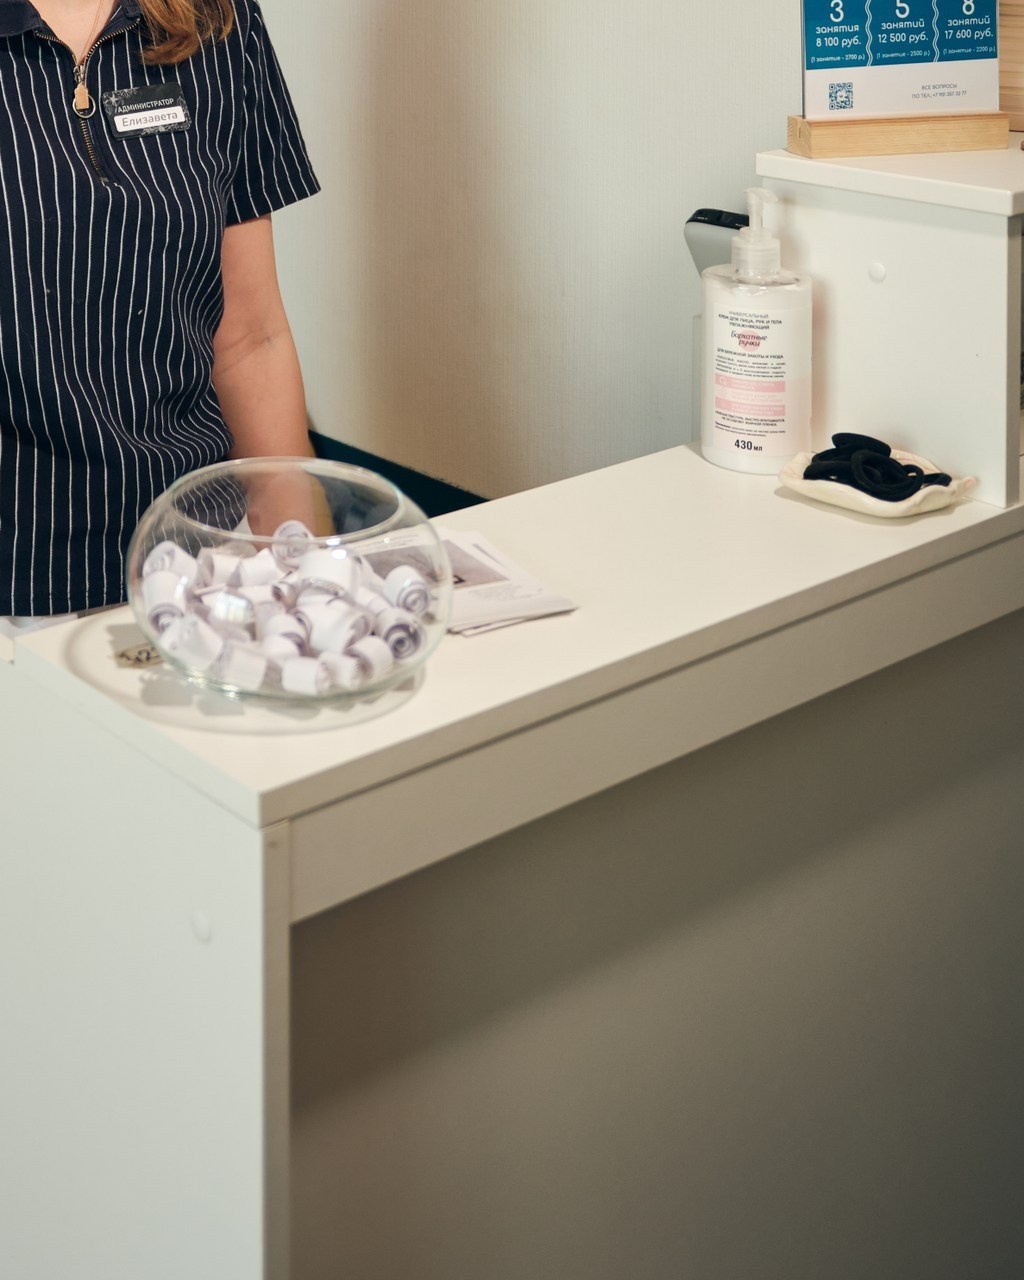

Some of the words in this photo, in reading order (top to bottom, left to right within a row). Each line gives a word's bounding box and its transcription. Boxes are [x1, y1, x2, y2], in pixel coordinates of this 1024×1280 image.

[830, 0, 844, 22] 3
[881, 18, 925, 30] занятий
[948, 15, 990, 27] занятий
[816, 25, 859, 34] занятия
[944, 30, 953, 39] 17
[956, 29, 972, 39] 600
[974, 28, 994, 40] руб.
[816, 37, 822, 47] 8
[824, 36, 839, 47] 100
[841, 35, 861, 48] руб.
[878, 33, 887, 43] 12
[890, 32, 906, 43] 500
[909, 31, 929, 44] руб.
[117, 97, 174, 113] АДМИНИСТРАТОР
[122, 112, 178, 127] Елизавета
[734, 439, 753, 450] 430
